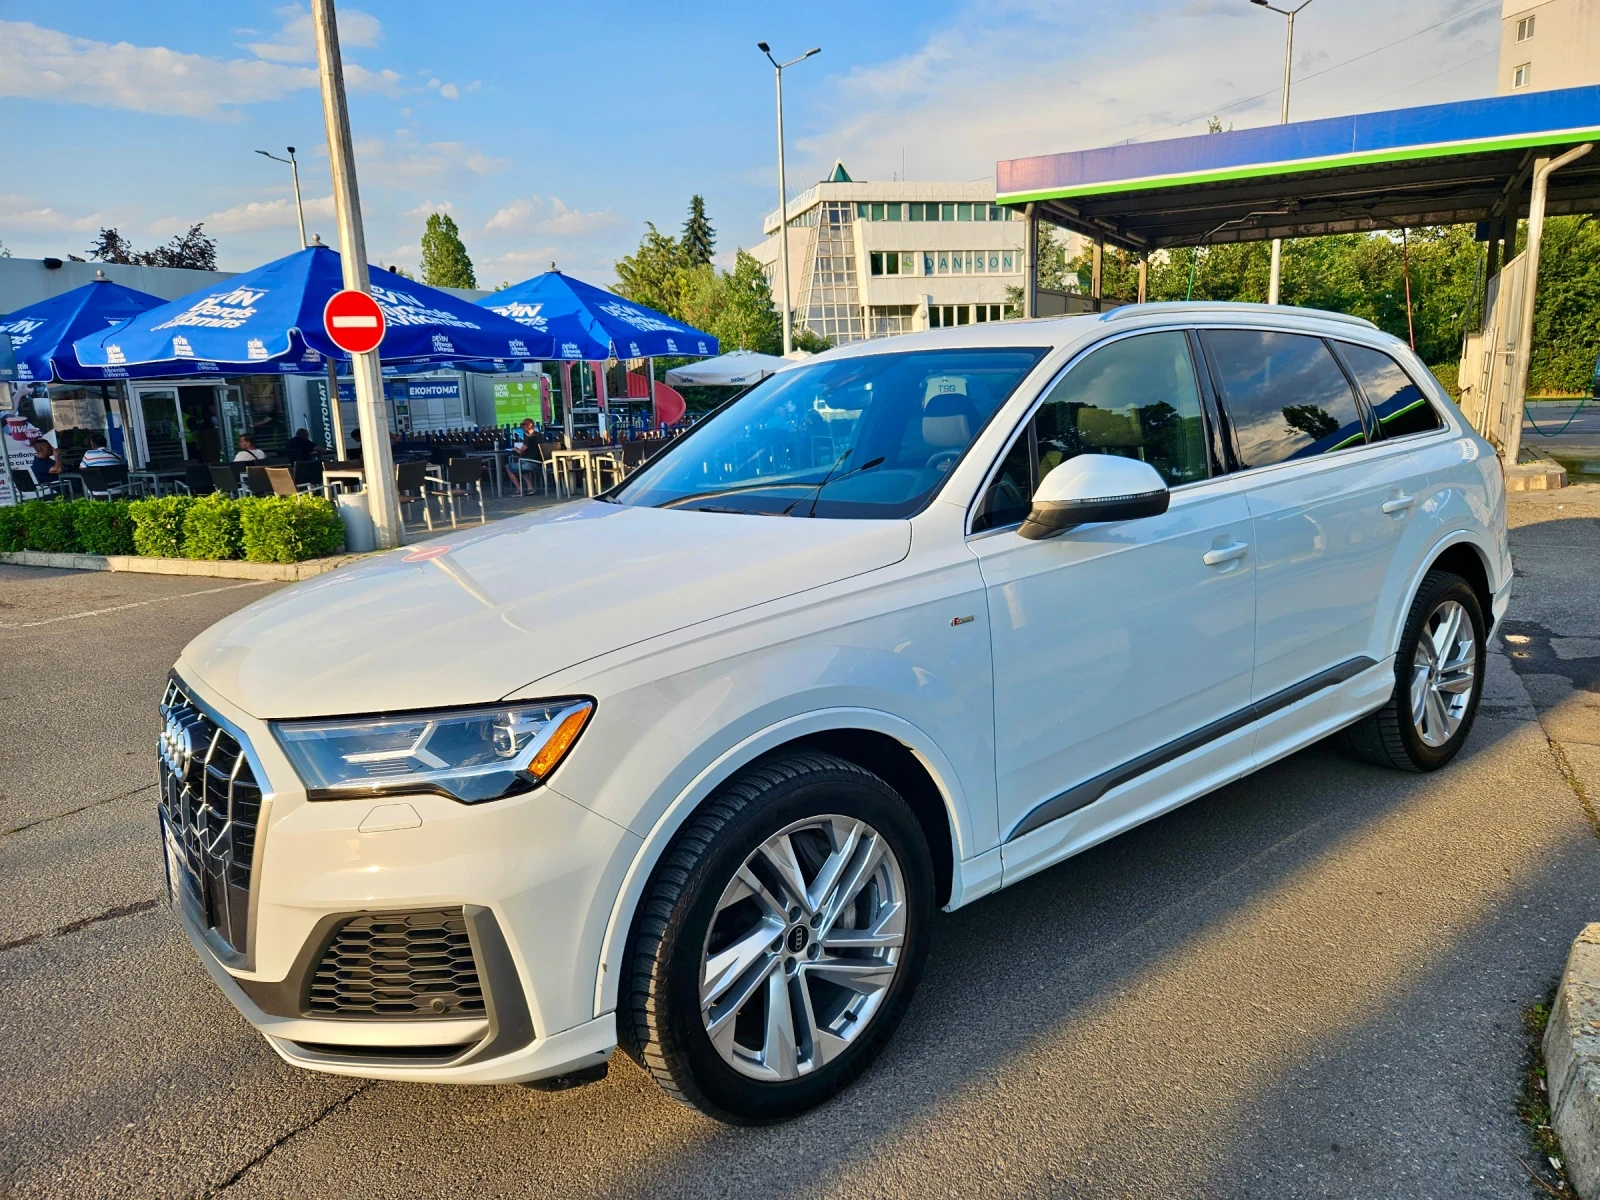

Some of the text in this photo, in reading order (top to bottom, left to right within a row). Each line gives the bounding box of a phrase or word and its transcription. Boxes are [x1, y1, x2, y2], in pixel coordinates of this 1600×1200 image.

[925, 256, 1012, 270] DANHSON
[409, 385, 459, 395] ЕКОНТОМАТ
[938, 384, 956, 392] TSG
[317, 382, 333, 450] КОНТОМАТ
